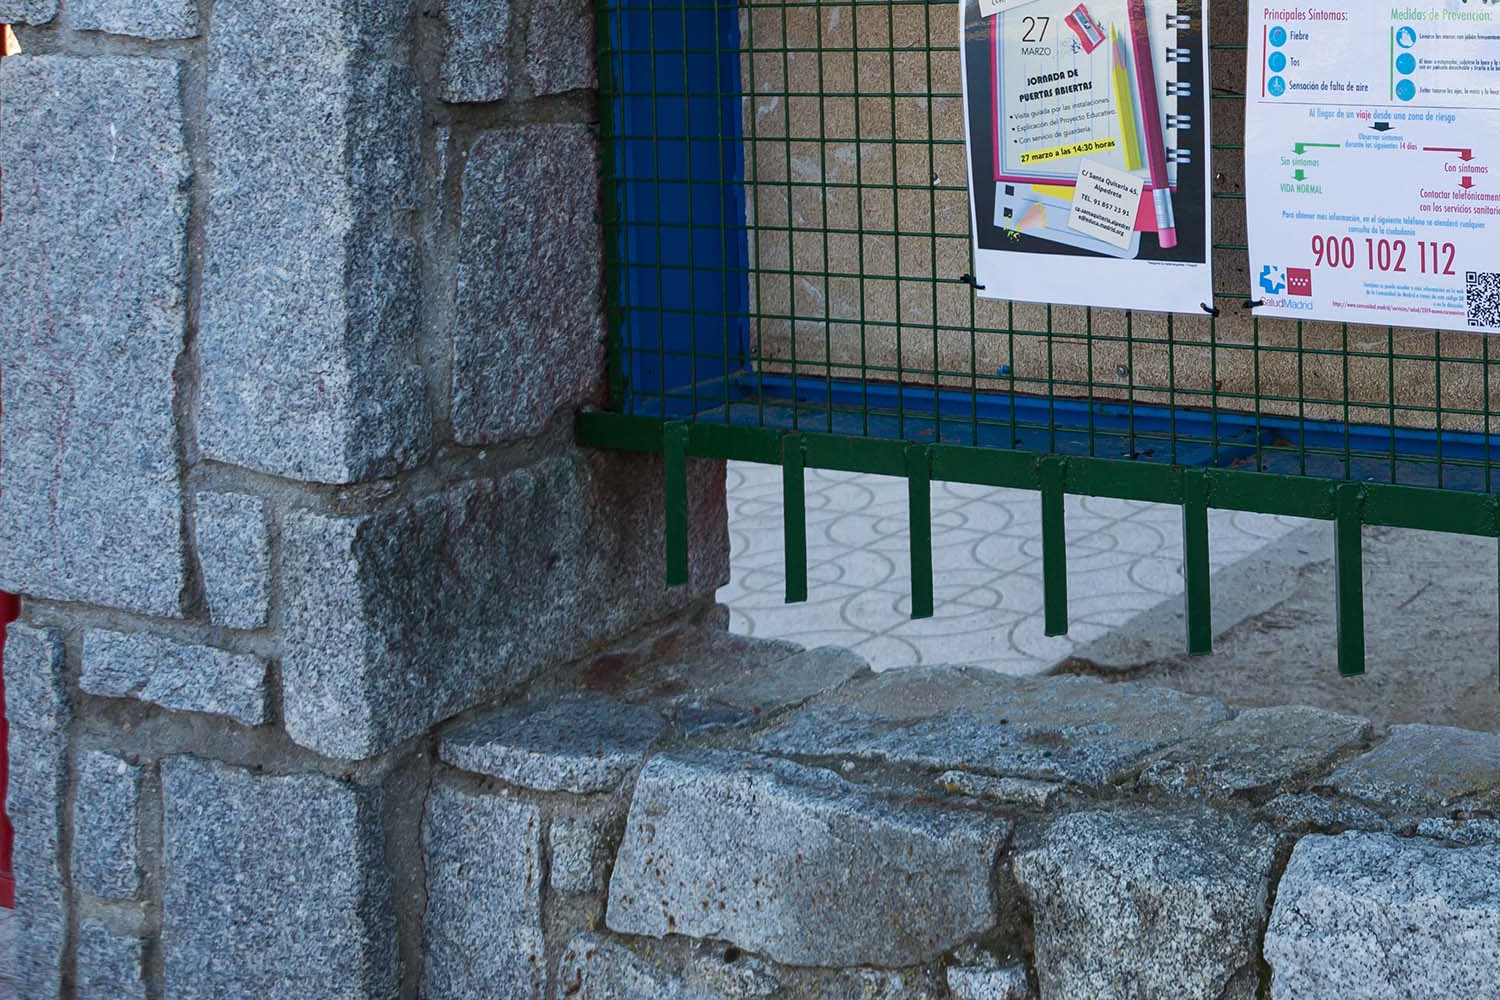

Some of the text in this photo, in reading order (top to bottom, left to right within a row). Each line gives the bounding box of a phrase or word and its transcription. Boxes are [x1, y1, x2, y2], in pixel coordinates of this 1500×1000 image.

[1263, 7, 1348, 22] Principales Síntomas:
[1391, 7, 1493, 21] Medidas de Prevención:
[1022, 16, 1050, 42] 27
[1290, 30, 1309, 40] Fiebre
[1021, 47, 1051, 56] MARZO
[1290, 57, 1301, 66] Tos
[1027, 69, 1079, 86] JORNADA DE
[1019, 81, 1093, 103] PUERTAS ABIERTAS
[1289, 80, 1369, 92] Sensación de falta de aire
[1309, 108, 1456, 124] Al llegar de un viaje desde una zona de riesgo
[1021, 154, 1030, 162] 27
[1031, 152, 1053, 161] marzo
[1073, 142, 1093, 153] 14:30
[1094, 140, 1116, 149] horas
[1280, 156, 1320, 167] Sin síntomas
[1444, 162, 1489, 174] Con síntomas
[1081, 169, 1089, 177] C/
[1089, 170, 1105, 183] Santa
[1105, 178, 1129, 191] Quiteria
[1094, 183, 1122, 198] Alpedrete
[1280, 183, 1322, 194] VIDA NORMAL
[1419, 188, 1451, 199] Contactar
[1081, 193, 1093, 203] TEL.
[1101, 200, 1113, 211] 857
[1113, 205, 1122, 214] 23
[1122, 209, 1130, 217] 91
[1419, 204, 1432, 212] con
[1432, 202, 1443, 212] los
[1444, 203, 1472, 214] servicios
[1311, 234, 1456, 275] 900 102 112
[1262, 296, 1313, 310] SaludMadrid
